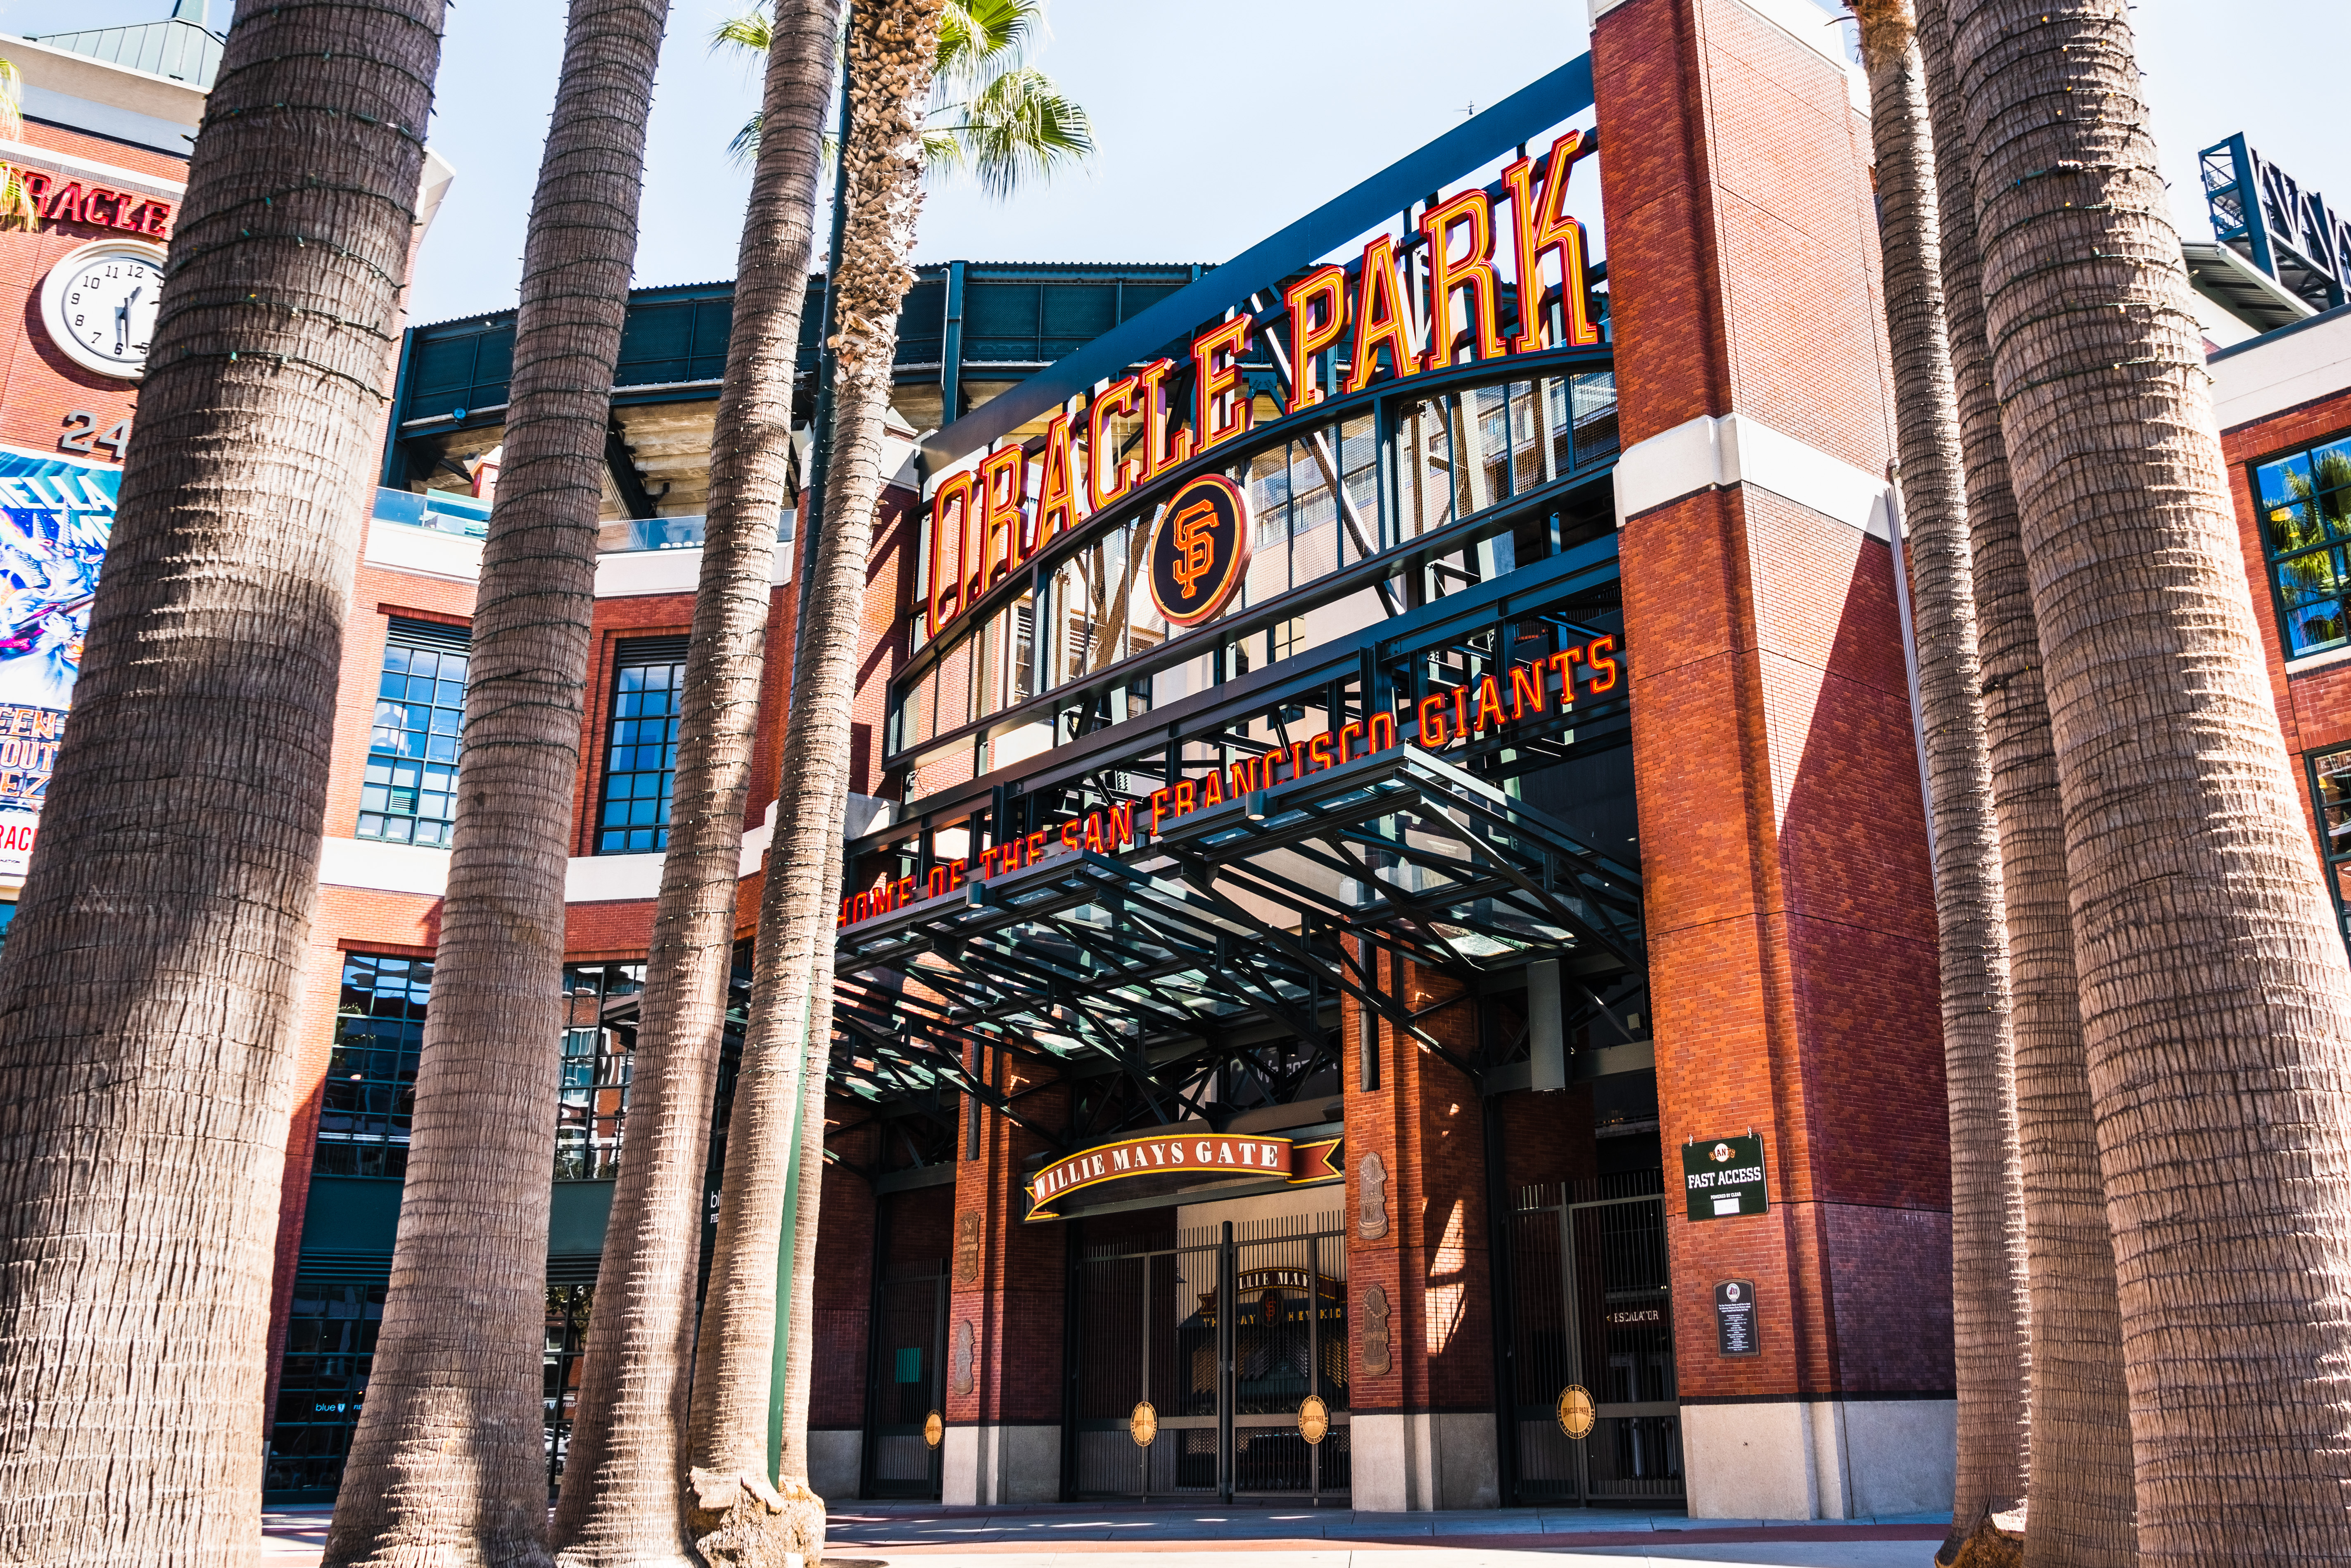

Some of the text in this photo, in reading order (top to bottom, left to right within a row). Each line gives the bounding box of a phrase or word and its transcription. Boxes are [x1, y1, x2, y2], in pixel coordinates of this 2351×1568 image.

[105, 266, 118, 278] 11
[127, 265, 143, 278] 12
[83, 276, 100, 289] 10
[71, 293, 80, 304] 9
[75, 314, 84, 326] 8
[91, 332, 102, 343] 7
[114, 342, 123, 355] 6
[927, 129, 1601, 639] ORACLE PARK
[62, 410, 131, 458] 24
[0, 476, 117, 511] ELLA
[1173, 499, 1220, 599] SF
[837, 634, 1620, 928] HOME OF THE SAN FRANCISCO GIANTS
[1709, 1148, 1735, 1160] GIANTS
[1035, 1141, 1278, 1200] WILLIE MAYS GATE
[1688, 1167, 1762, 1189] FAST ACCESS
[710, 1190, 720, 1208] bl
[710, 1213, 719, 1223] FIE
[962, 1235, 975, 1243] WORLD
[959, 1243, 978, 1252] CHAMPIONS
[1278, 1272, 1310, 1287] MAY
[1363, 1331, 1387, 1343] CHAMPIONS
[1562, 1388, 1572, 1398] HOME
[1563, 1407, 1590, 1418] ORACLE PARK
